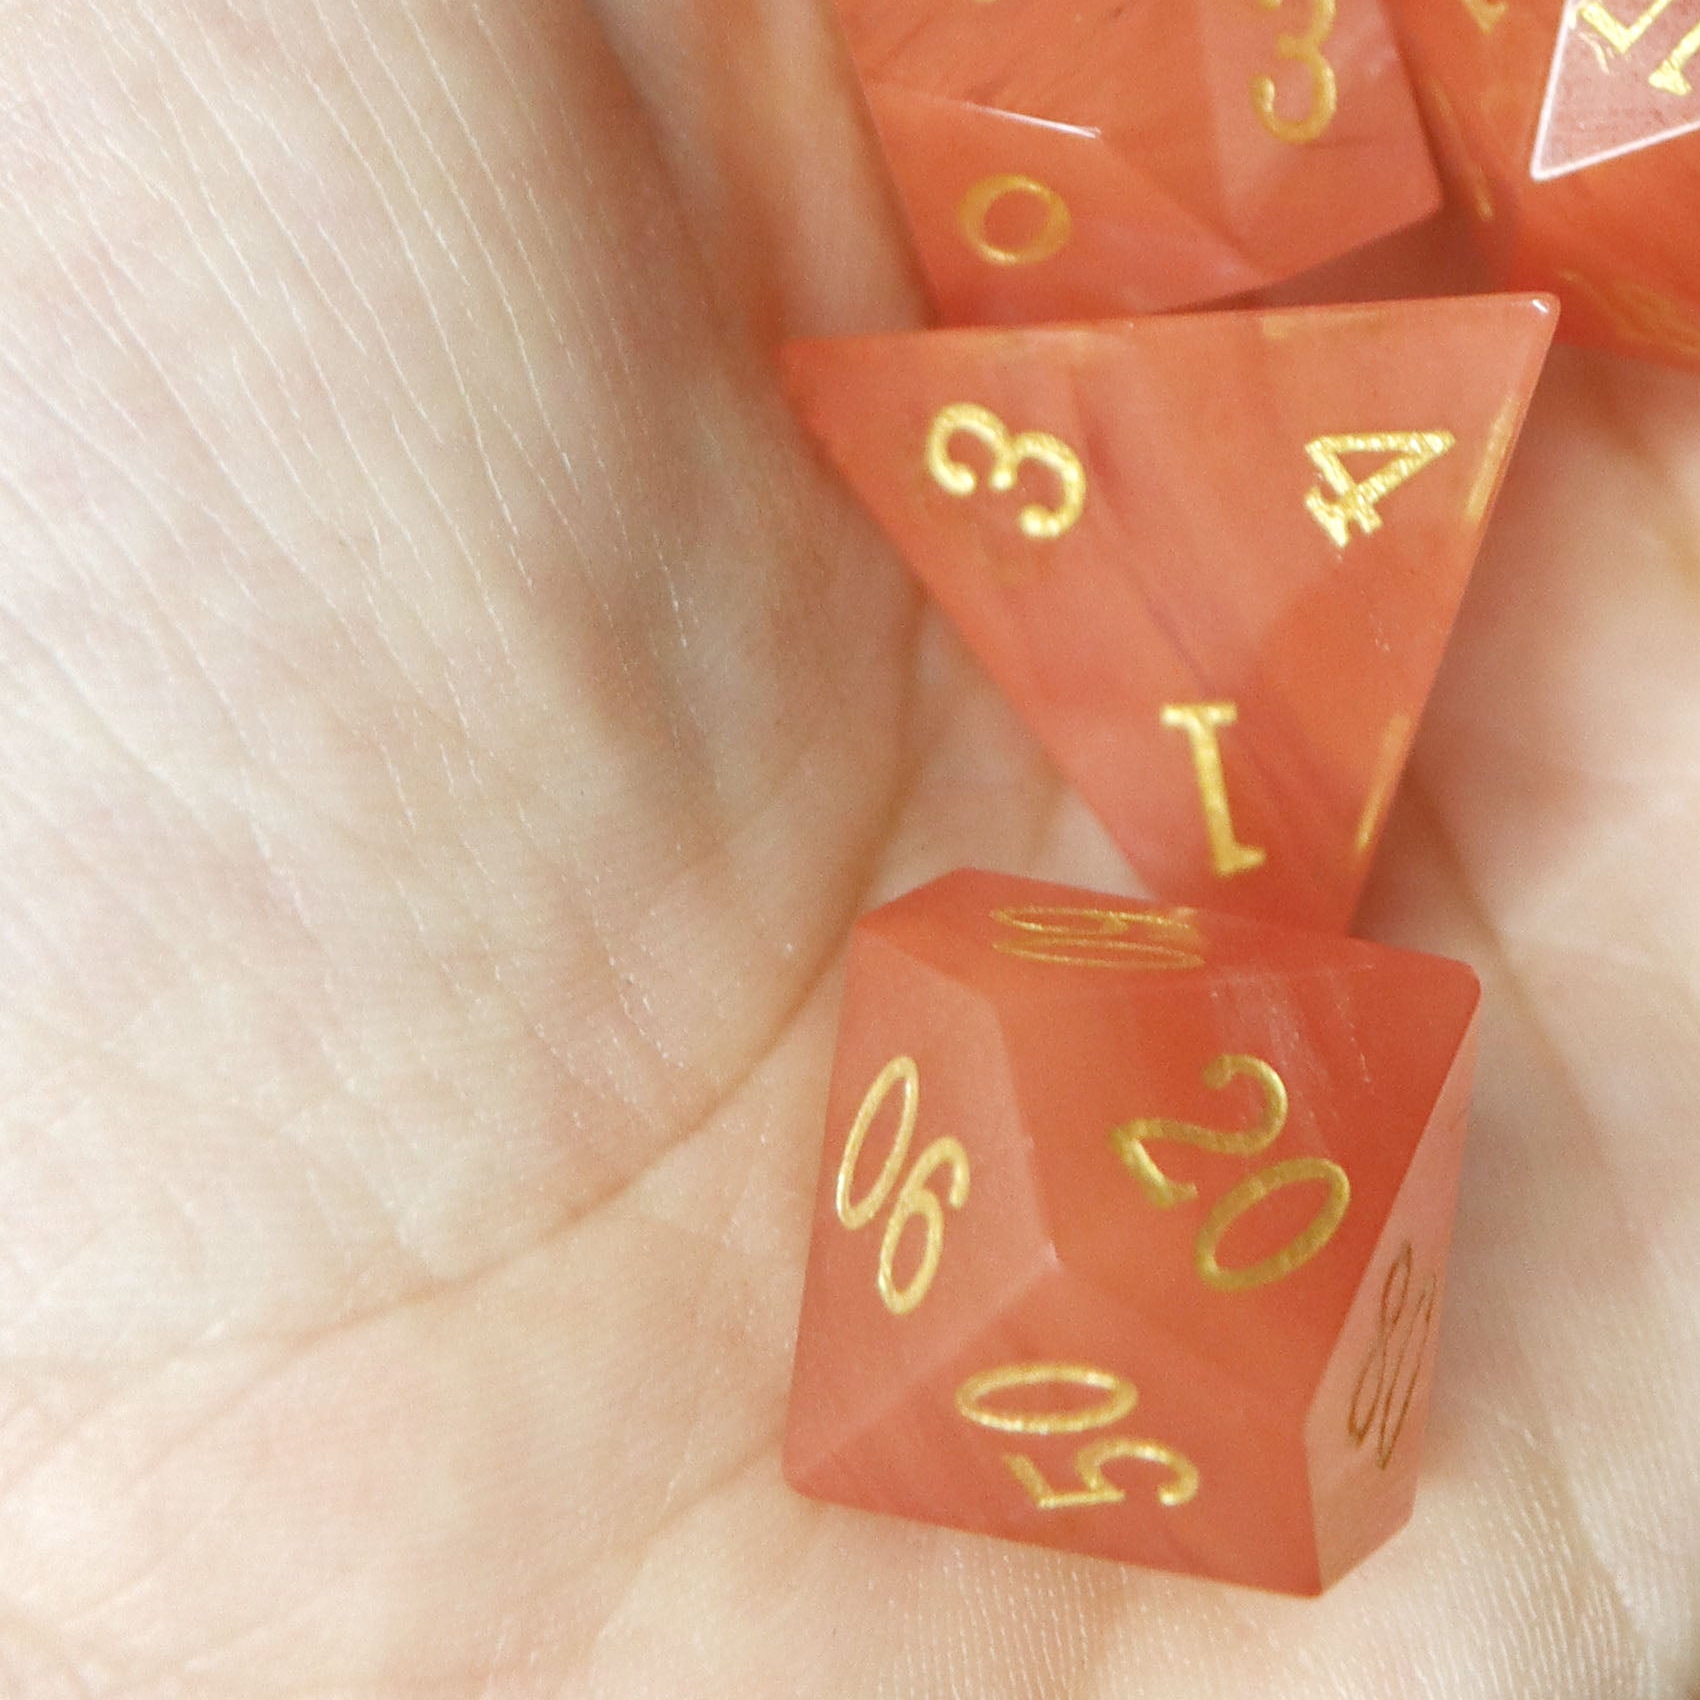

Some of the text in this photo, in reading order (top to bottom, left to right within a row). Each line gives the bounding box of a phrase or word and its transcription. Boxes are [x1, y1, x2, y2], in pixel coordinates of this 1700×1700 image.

[958, 173, 1073, 267] 0
[926, 402, 1086, 541] 3
[1304, 430, 1456, 548] 4
[1161, 702, 1266, 877] 1
[1110, 1054, 1351, 1292] 20
[1347, 1240, 1438, 1472] 80
[955, 1362, 1199, 1508] 50
